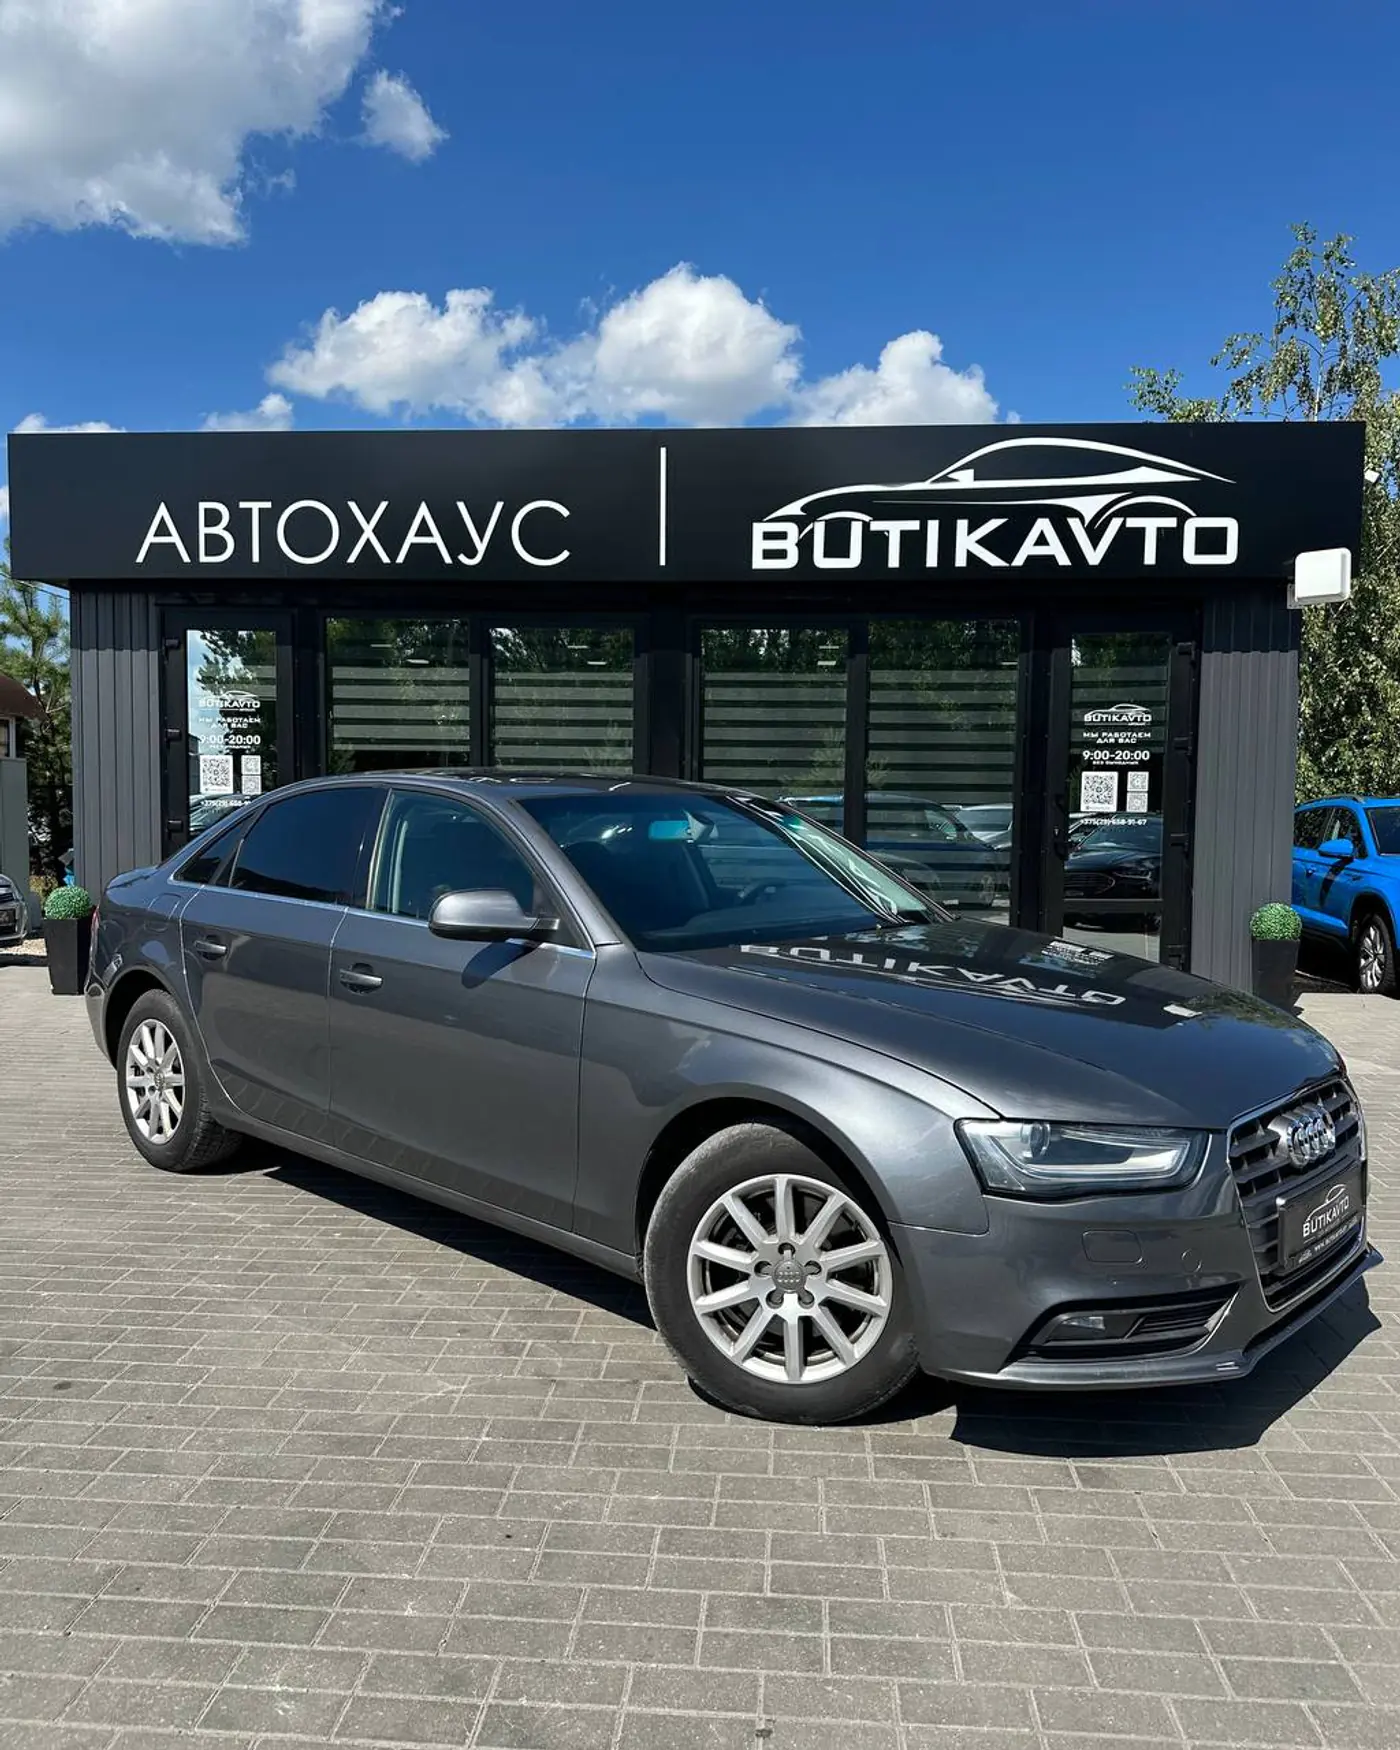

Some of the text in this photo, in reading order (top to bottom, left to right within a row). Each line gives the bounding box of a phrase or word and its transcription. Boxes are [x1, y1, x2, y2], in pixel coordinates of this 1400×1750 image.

[135, 499, 572, 567] АВТОХАУС
[751, 515, 1240, 570] BUTIKAVTO
[1083, 713, 1152, 722] BUTIKAVTO
[200, 735, 261, 745] 9:00-20:00
[1082, 750, 1150, 761] 9:00-20:00
[1302, 1195, 1350, 1238] BUTIKAVTO
